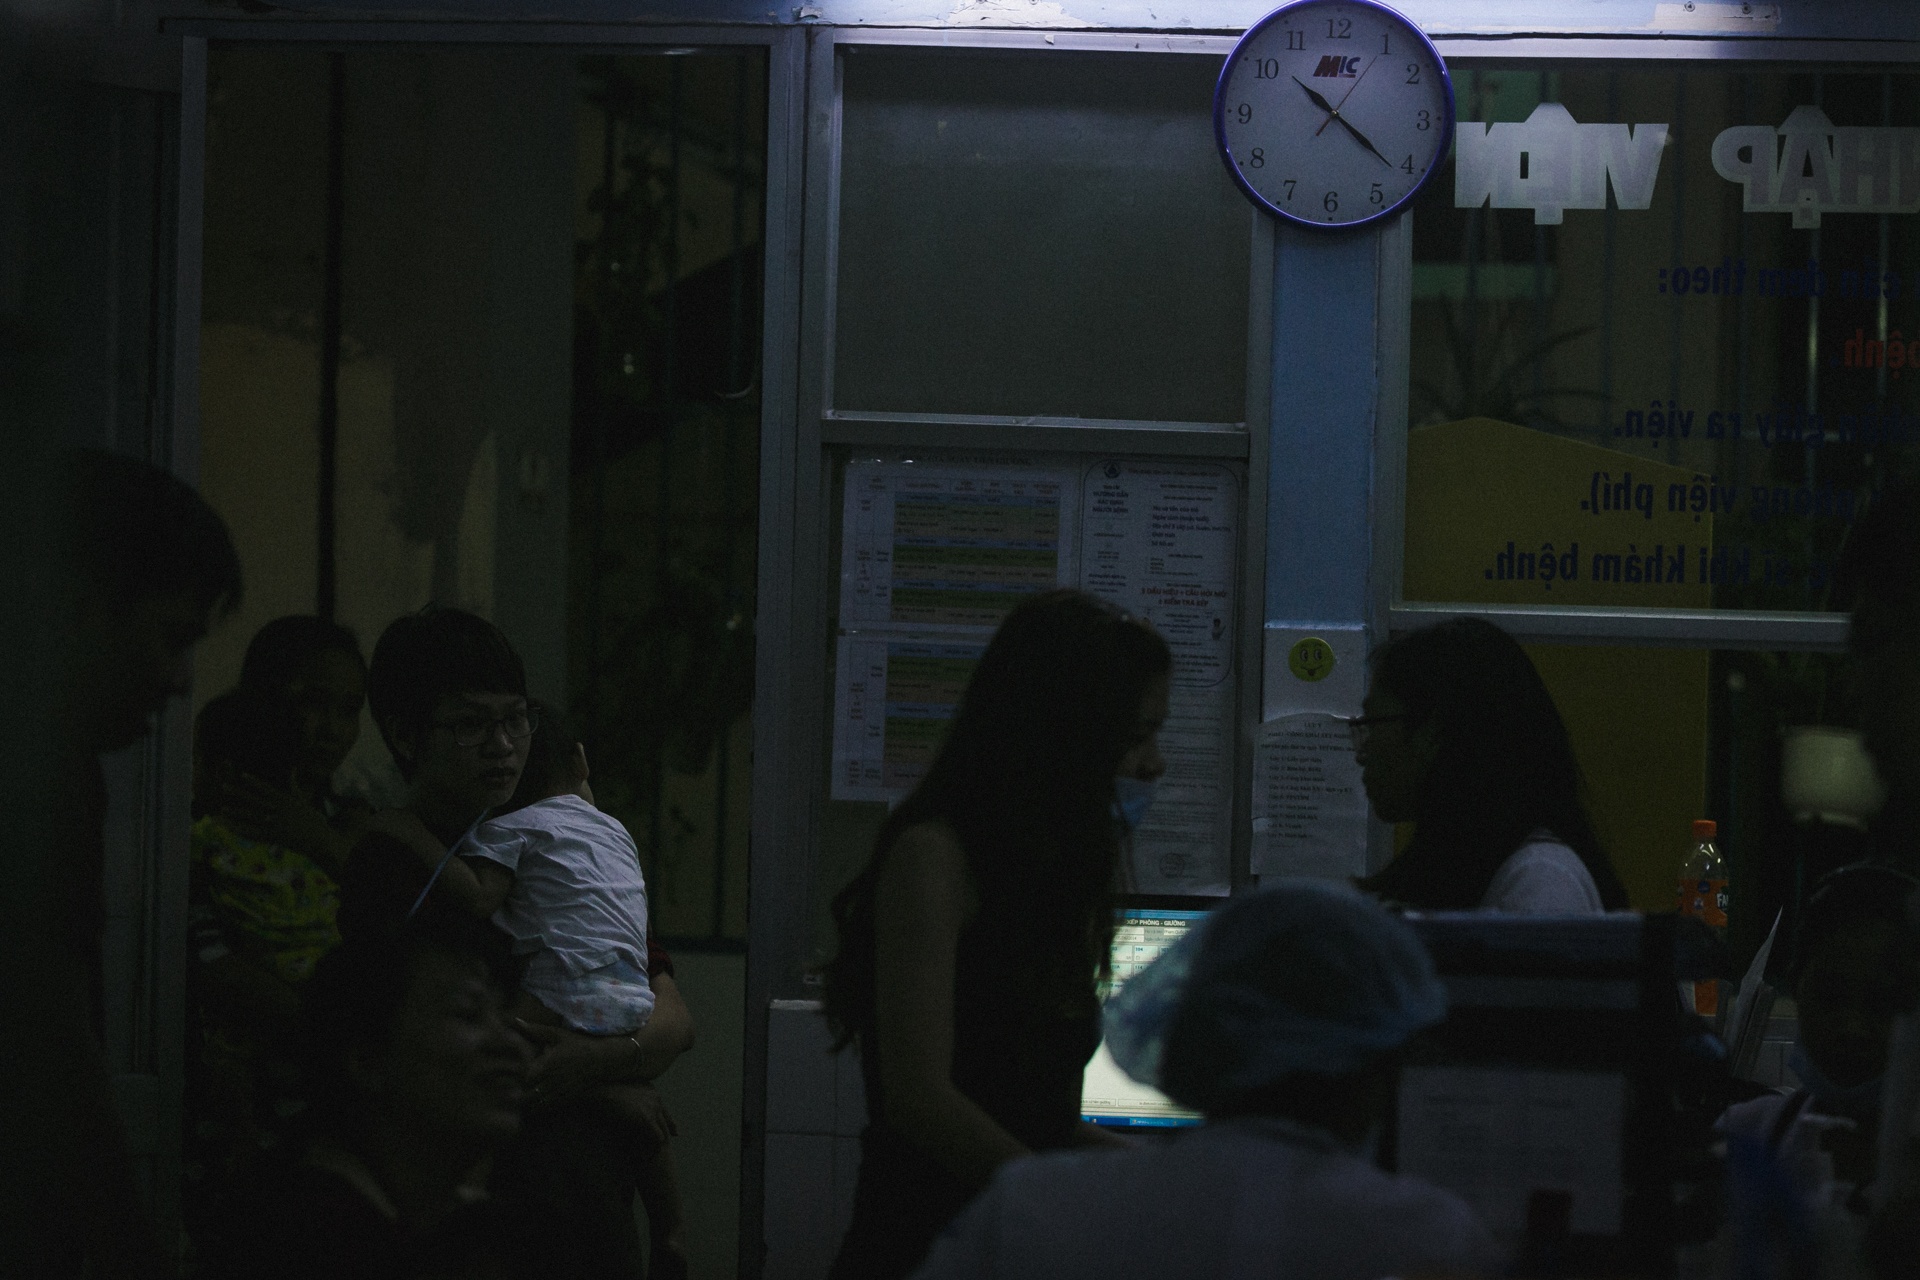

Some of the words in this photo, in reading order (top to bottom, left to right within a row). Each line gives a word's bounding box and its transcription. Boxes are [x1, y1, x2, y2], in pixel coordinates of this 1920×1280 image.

[1326, 18, 1351, 39] 12
[1285, 30, 1306, 51] 11
[1381, 33, 1391, 55] 1
[1254, 58, 1279, 79] 10
[1313, 55, 1361, 78] MIC
[1406, 64, 1420, 84] 2
[1238, 104, 1252, 124] 9
[1416, 110, 1431, 131] 3
[1250, 147, 1265, 169] 8
[1401, 154, 1415, 175] 4
[1284, 180, 1297, 201] 7
[1370, 183, 1384, 204] 5
[1324, 191, 1338, 213] 6
[1139, 918, 1160, 926] PHÒNG
